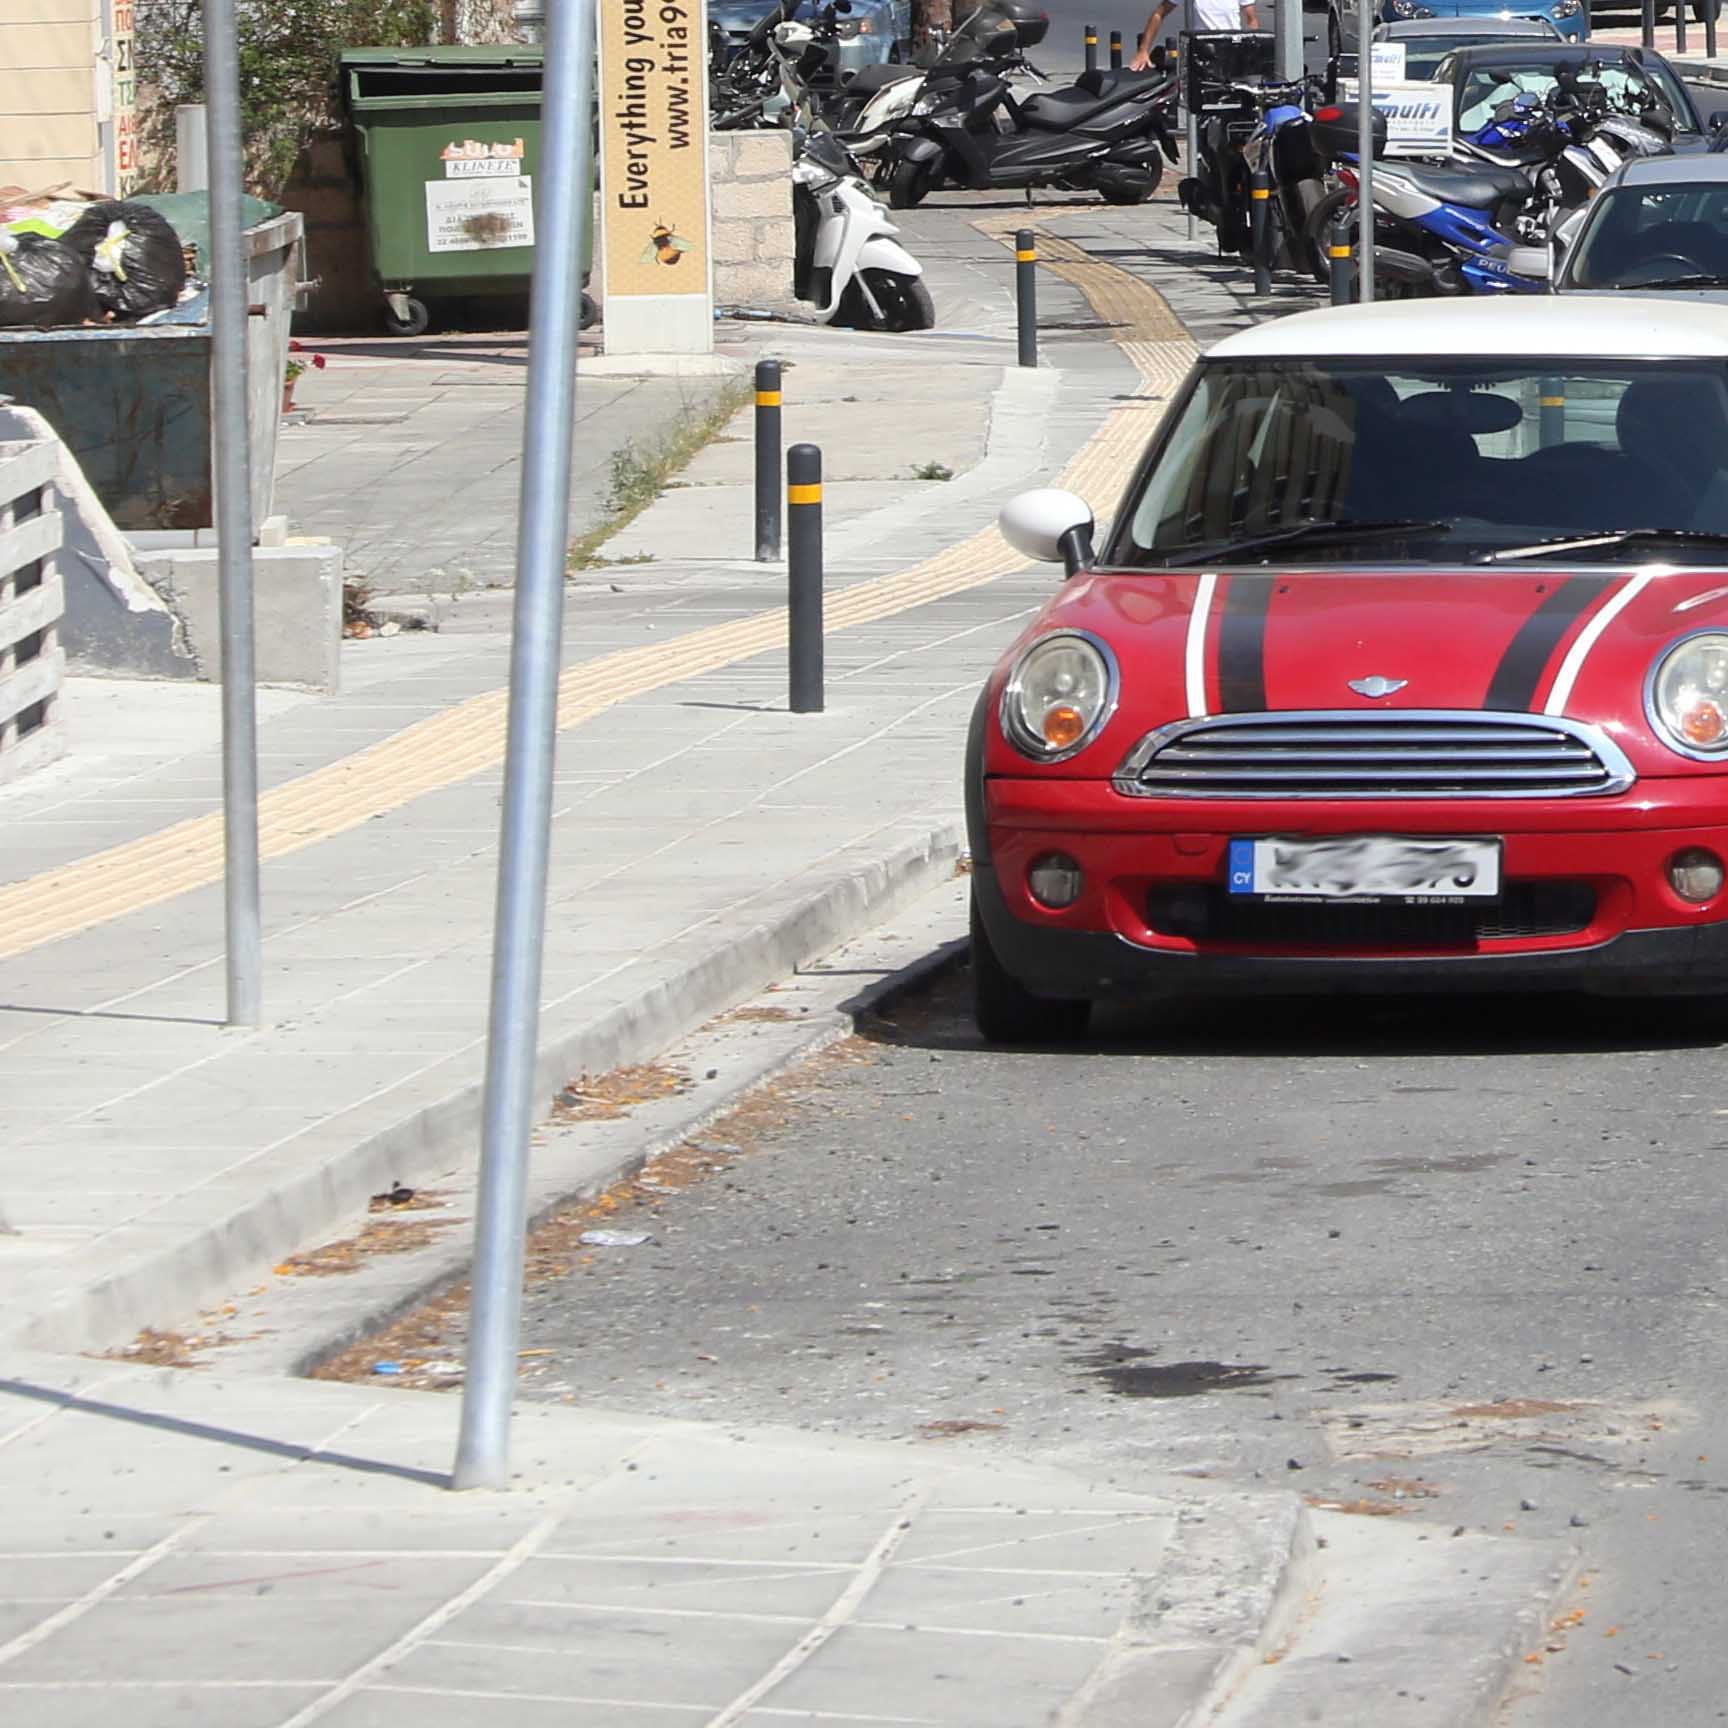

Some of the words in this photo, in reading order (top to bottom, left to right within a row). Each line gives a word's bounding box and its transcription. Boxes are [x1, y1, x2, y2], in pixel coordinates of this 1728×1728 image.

[624, 0, 655, 46] you
[616, 57, 657, 209] Everything
[1233, 872, 1251, 884] CY
